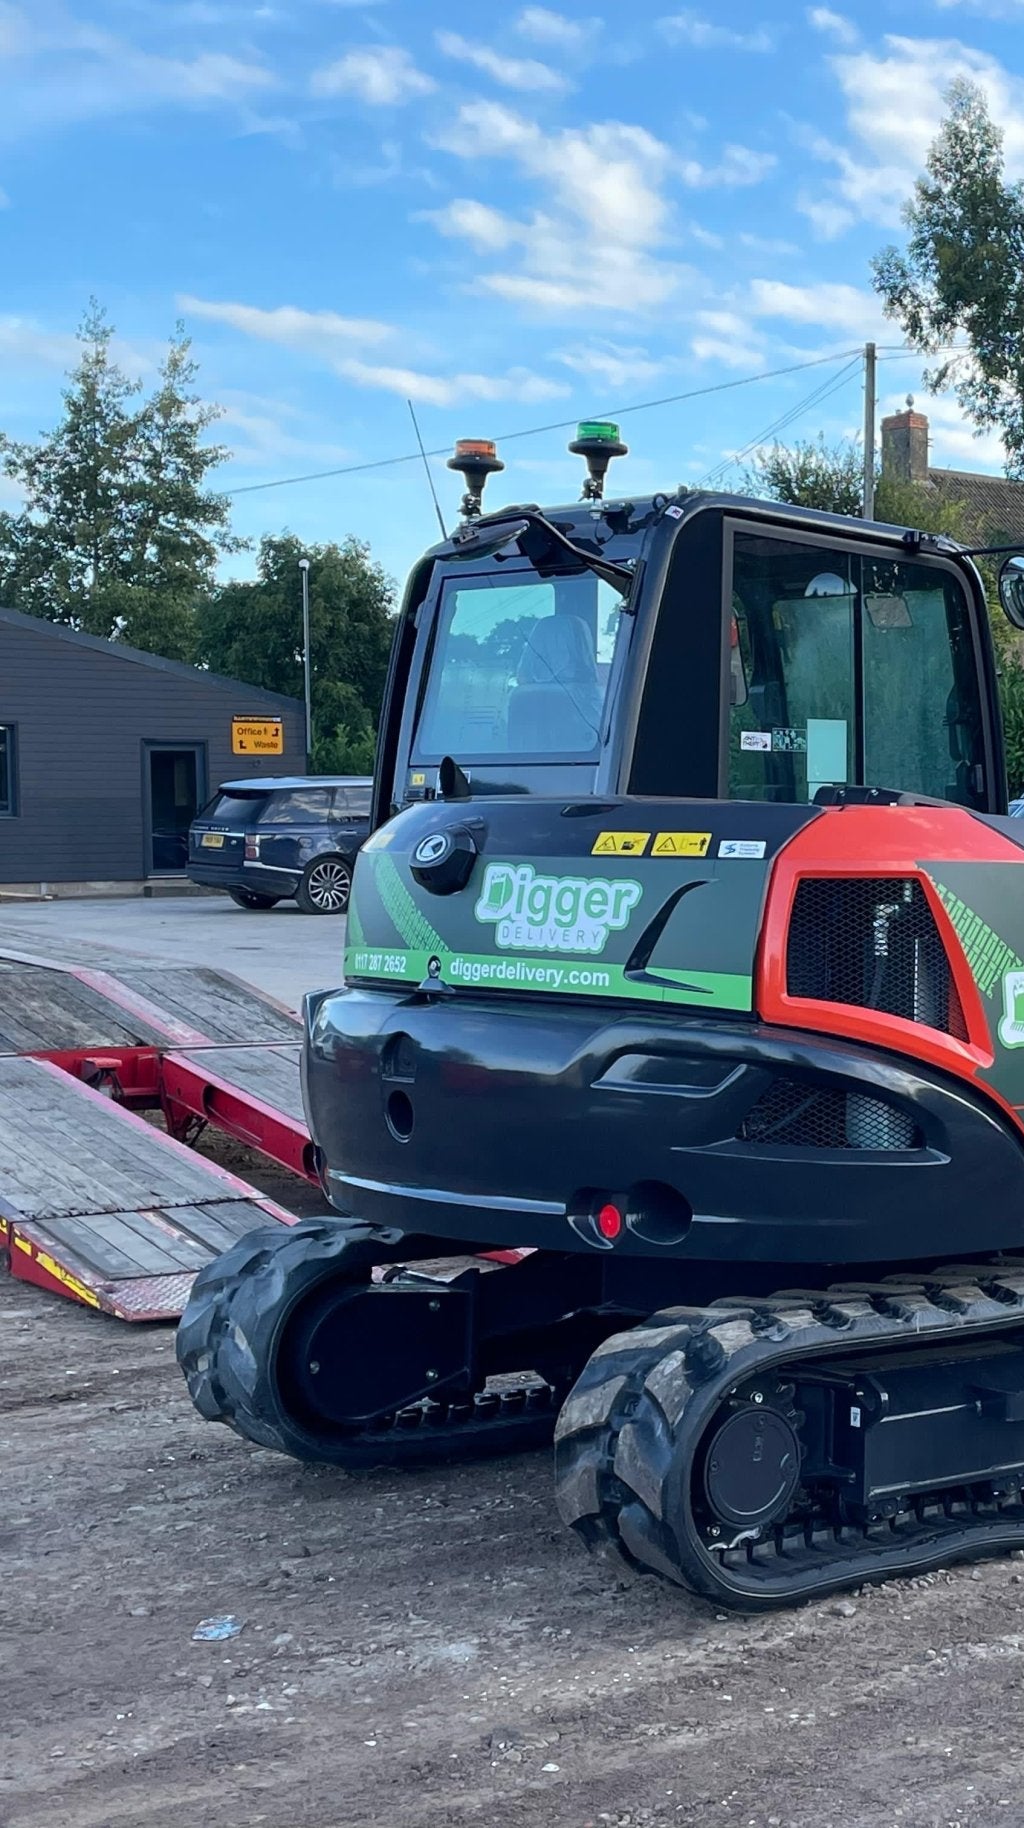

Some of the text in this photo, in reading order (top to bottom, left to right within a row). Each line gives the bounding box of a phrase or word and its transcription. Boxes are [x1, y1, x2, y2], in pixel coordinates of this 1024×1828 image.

[236, 727, 263, 736] Office
[253, 740, 278, 749] Waste
[483, 872, 634, 929] Digger
[502, 925, 601, 944] DELIVERY
[368, 954, 382, 972] 287
[383, 956, 407, 974] 2652
[450, 957, 610, 988] diggerdelivery.com
